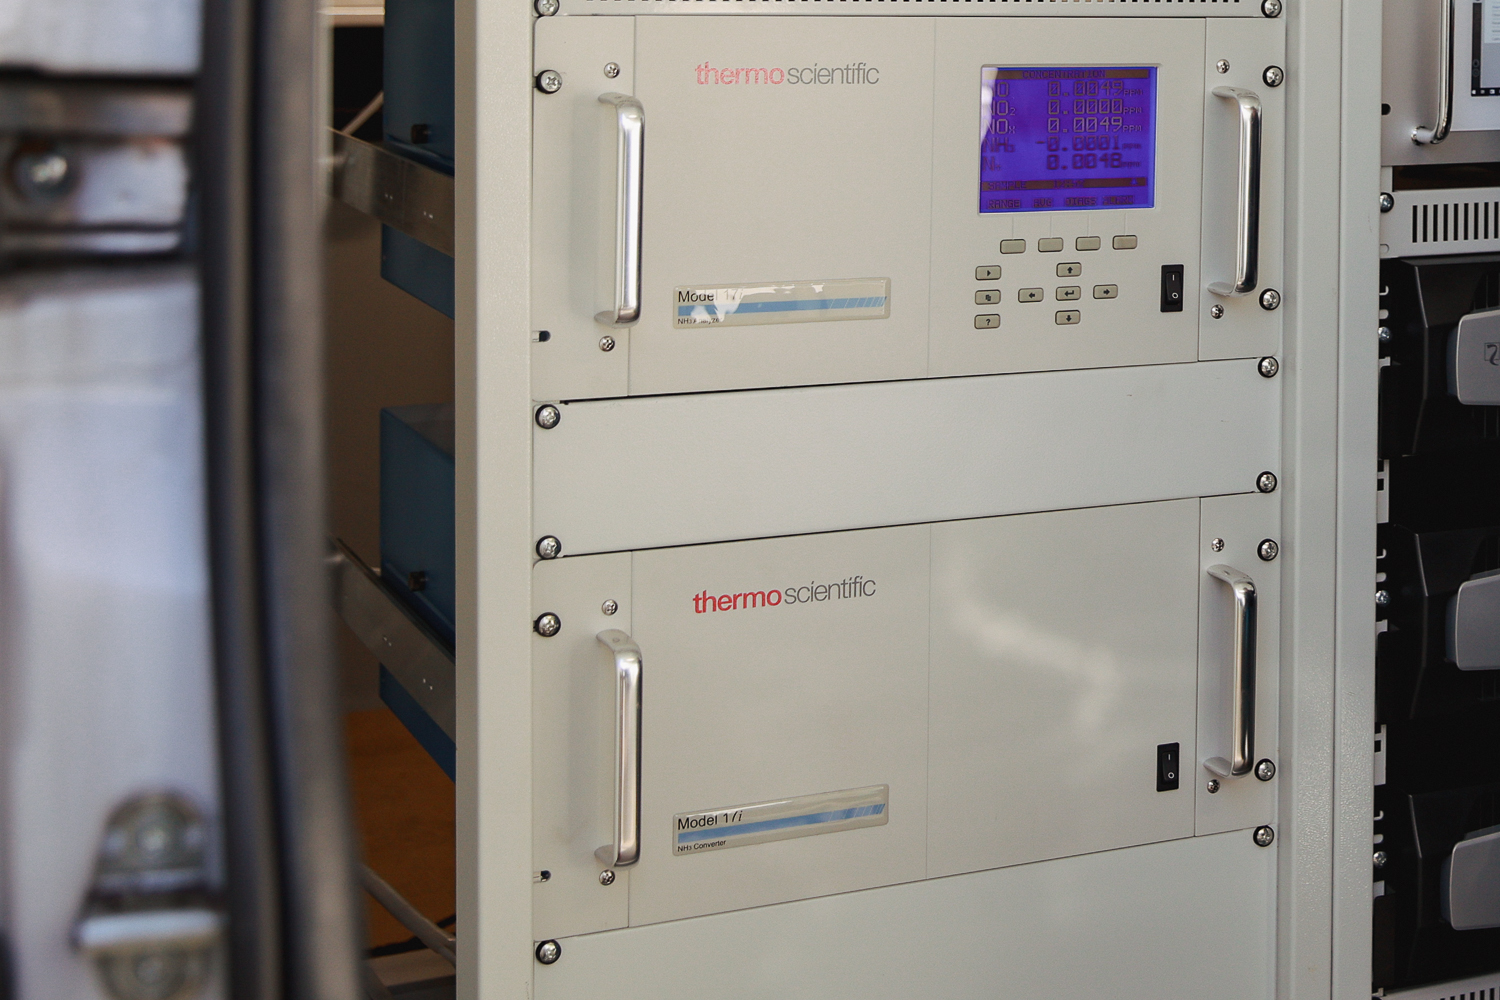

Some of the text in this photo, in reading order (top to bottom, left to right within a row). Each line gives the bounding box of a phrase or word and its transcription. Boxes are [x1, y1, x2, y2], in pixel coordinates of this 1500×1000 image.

[695, 62, 879, 86] thermo scientific
[988, 181, 1026, 190] SAMPLE
[988, 200, 1020, 209] RANGE
[1065, 197, 1096, 206] DIAGS
[679, 290, 717, 302] Model
[693, 576, 876, 614] thermo scientific
[678, 815, 717, 830] Model
[694, 840, 726, 849] Converter
